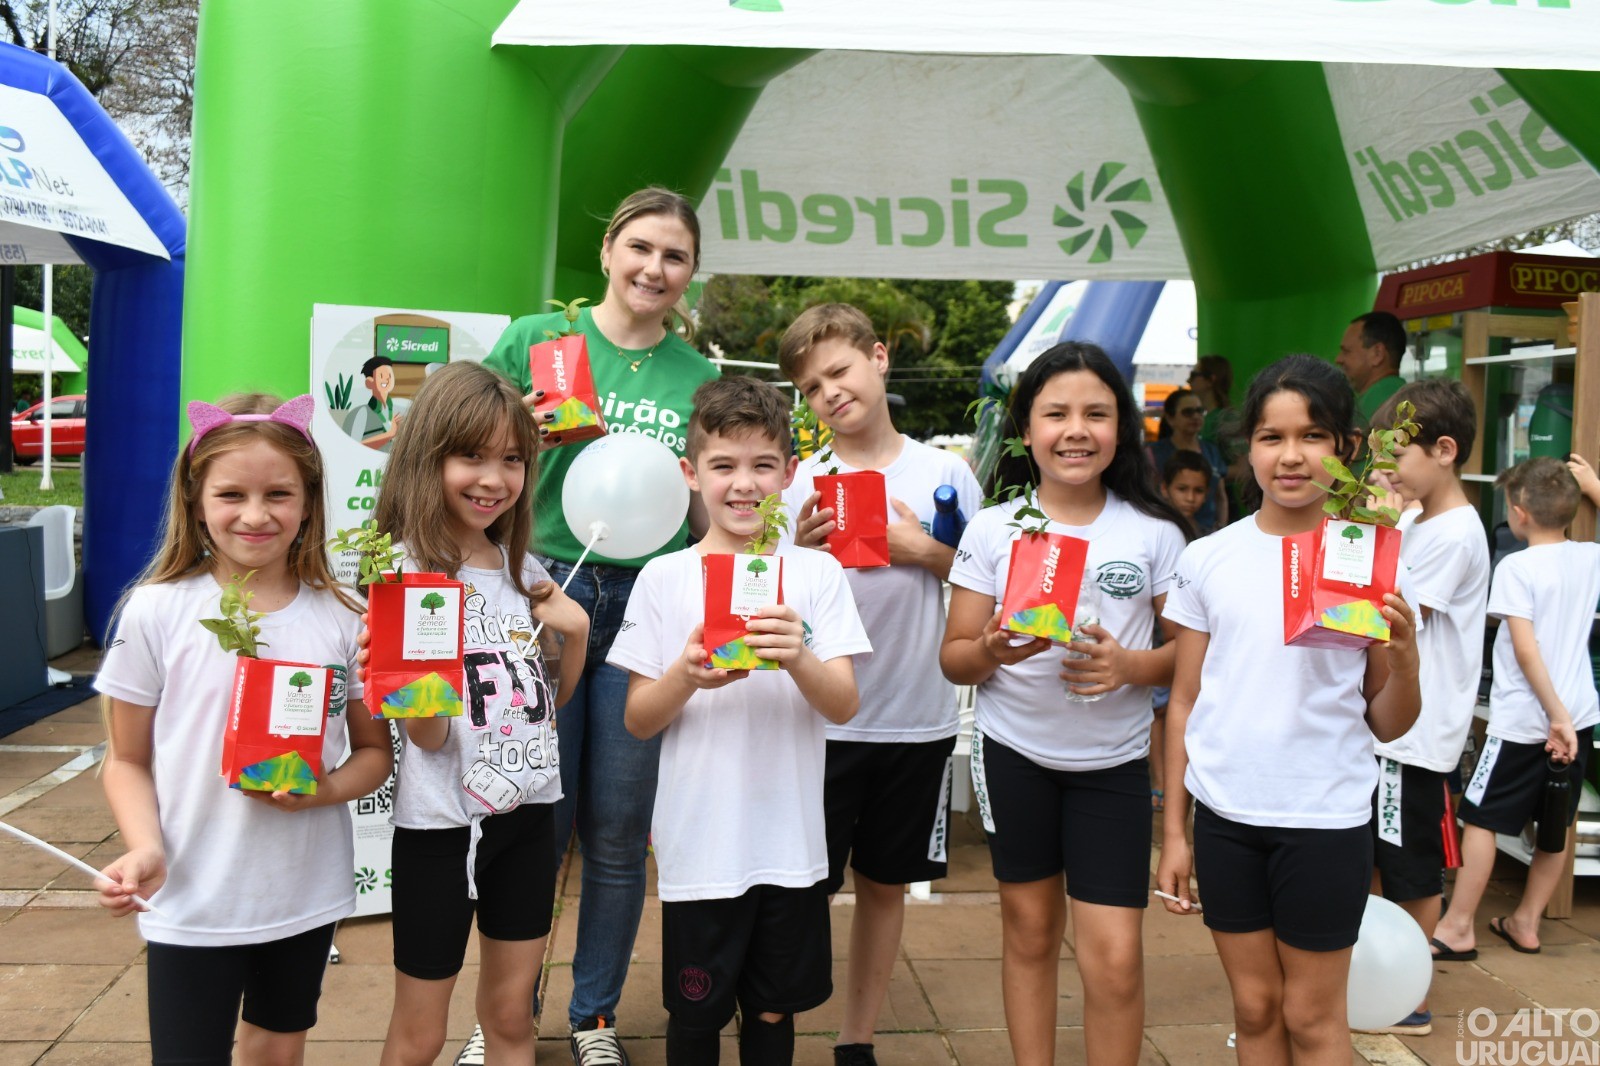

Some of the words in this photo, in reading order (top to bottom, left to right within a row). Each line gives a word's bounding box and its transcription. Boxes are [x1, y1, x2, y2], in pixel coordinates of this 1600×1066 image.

[1403, 277, 1465, 305] PIPOCA
[401, 340, 439, 352] Sicredi
[552, 349, 567, 391] creluz
[1043, 545, 1061, 594] creluz
[503, 706, 530, 725] pretty
